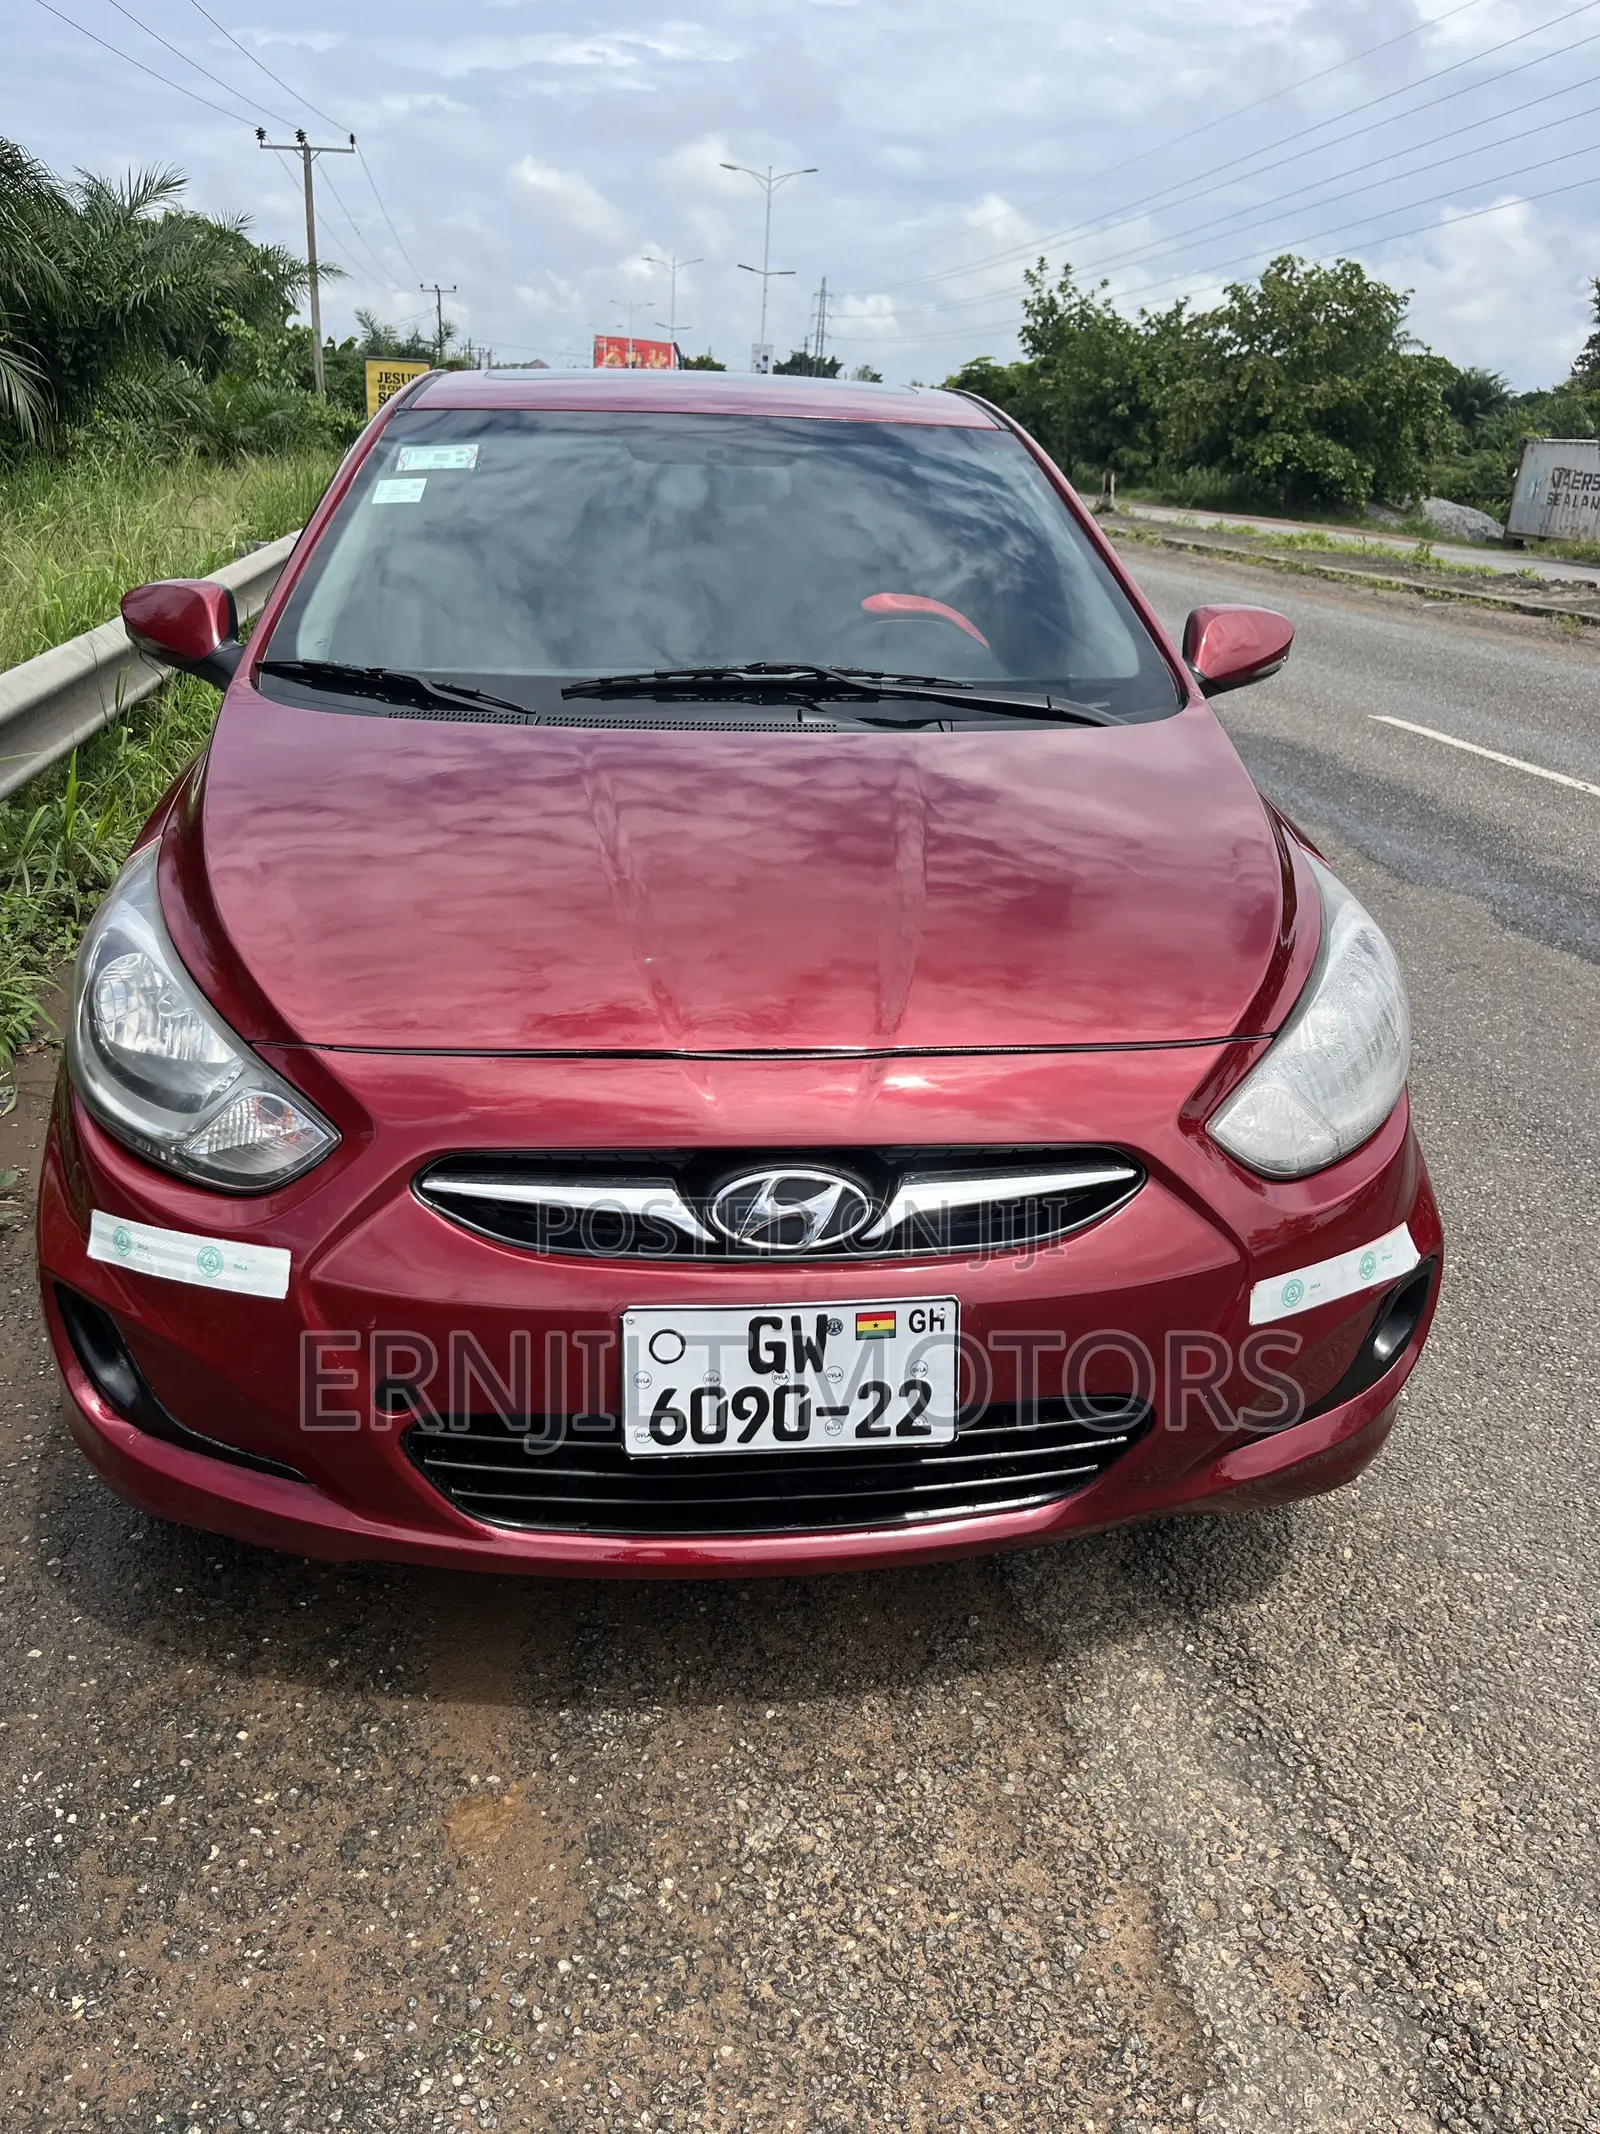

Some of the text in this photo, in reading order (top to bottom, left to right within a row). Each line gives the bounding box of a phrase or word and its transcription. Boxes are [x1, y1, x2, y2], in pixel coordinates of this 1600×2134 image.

[748, 1308, 945, 1374] GW GH
[635, 1377, 651, 1385] DVLA
[705, 1376, 721, 1384] DVLA
[650, 1379, 932, 1446] 6090-22
